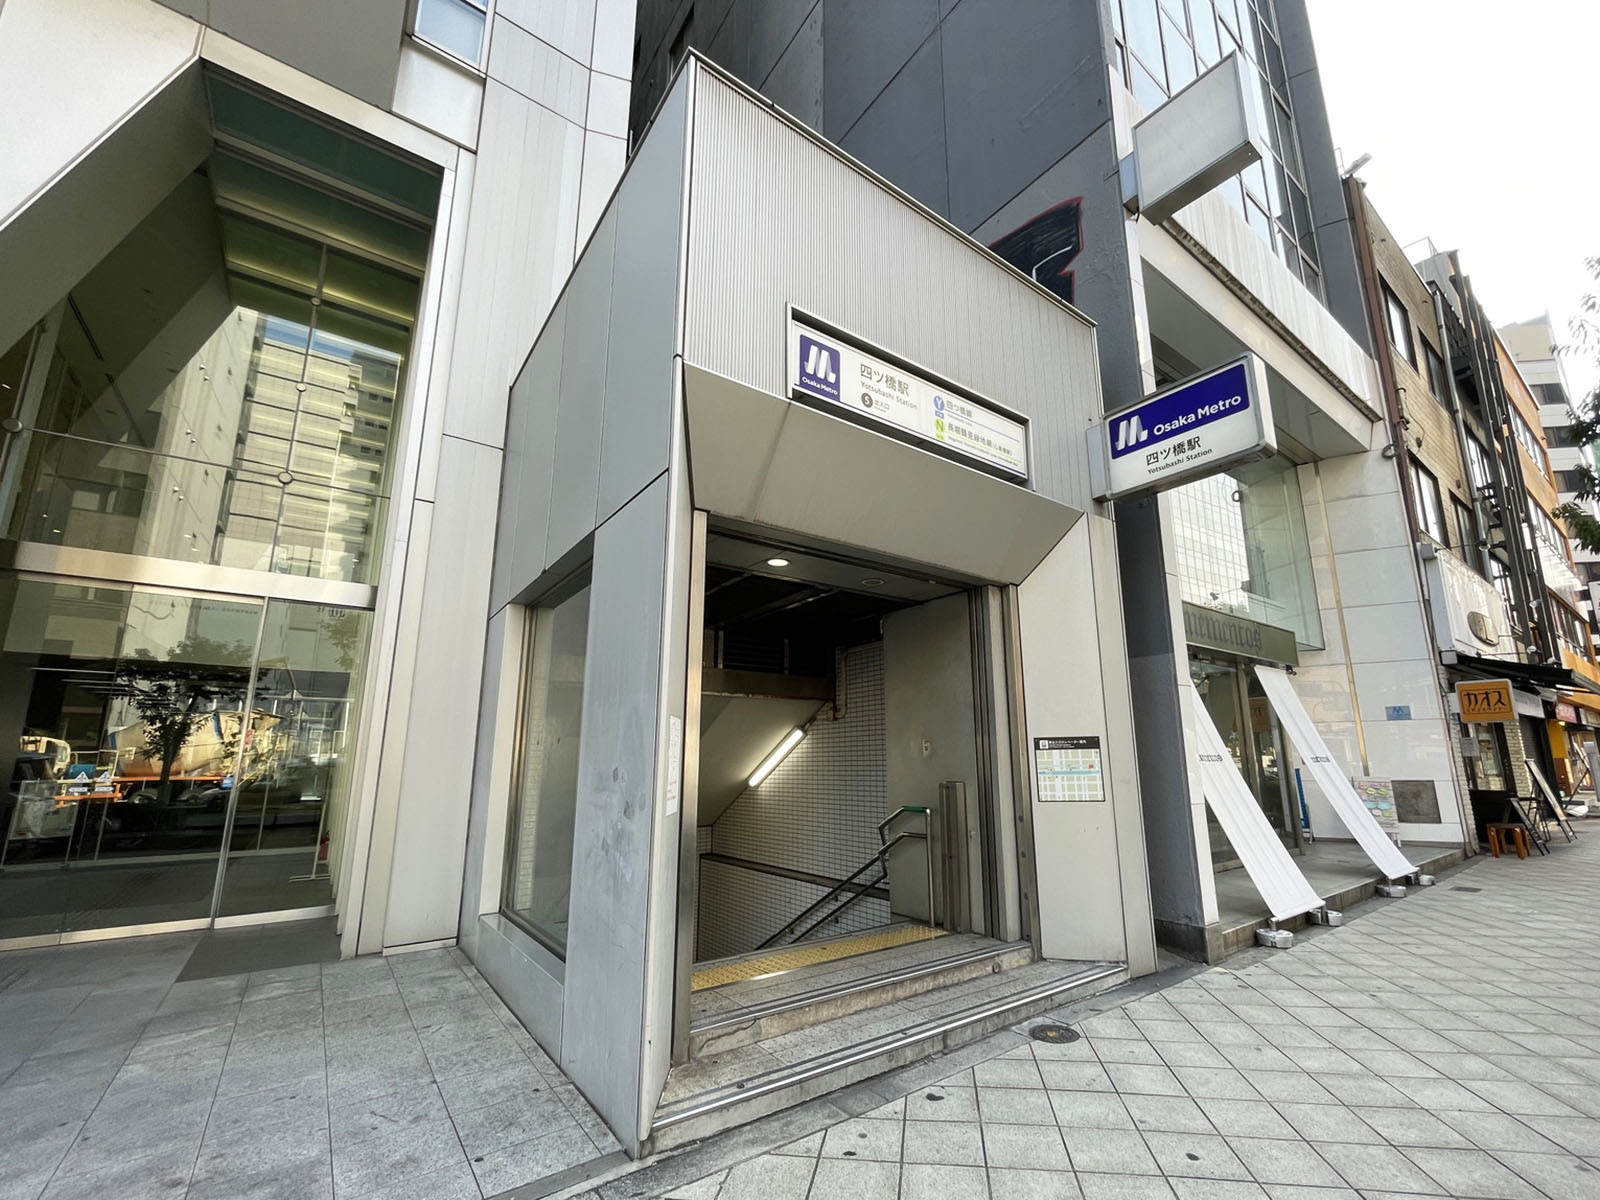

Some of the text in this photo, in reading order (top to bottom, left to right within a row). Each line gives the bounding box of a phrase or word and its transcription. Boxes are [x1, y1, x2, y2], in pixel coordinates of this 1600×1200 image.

[801, 376, 839, 395] Osaka Metro
[860, 363, 909, 397] 四ツ橋駅
[1153, 395, 1242, 436] Osaka Metro
[1145, 435, 1202, 466] 四ツ橋駅
[1147, 448, 1213, 475] Yotsubashi Station
[1463, 690, 1507, 708] カオス
